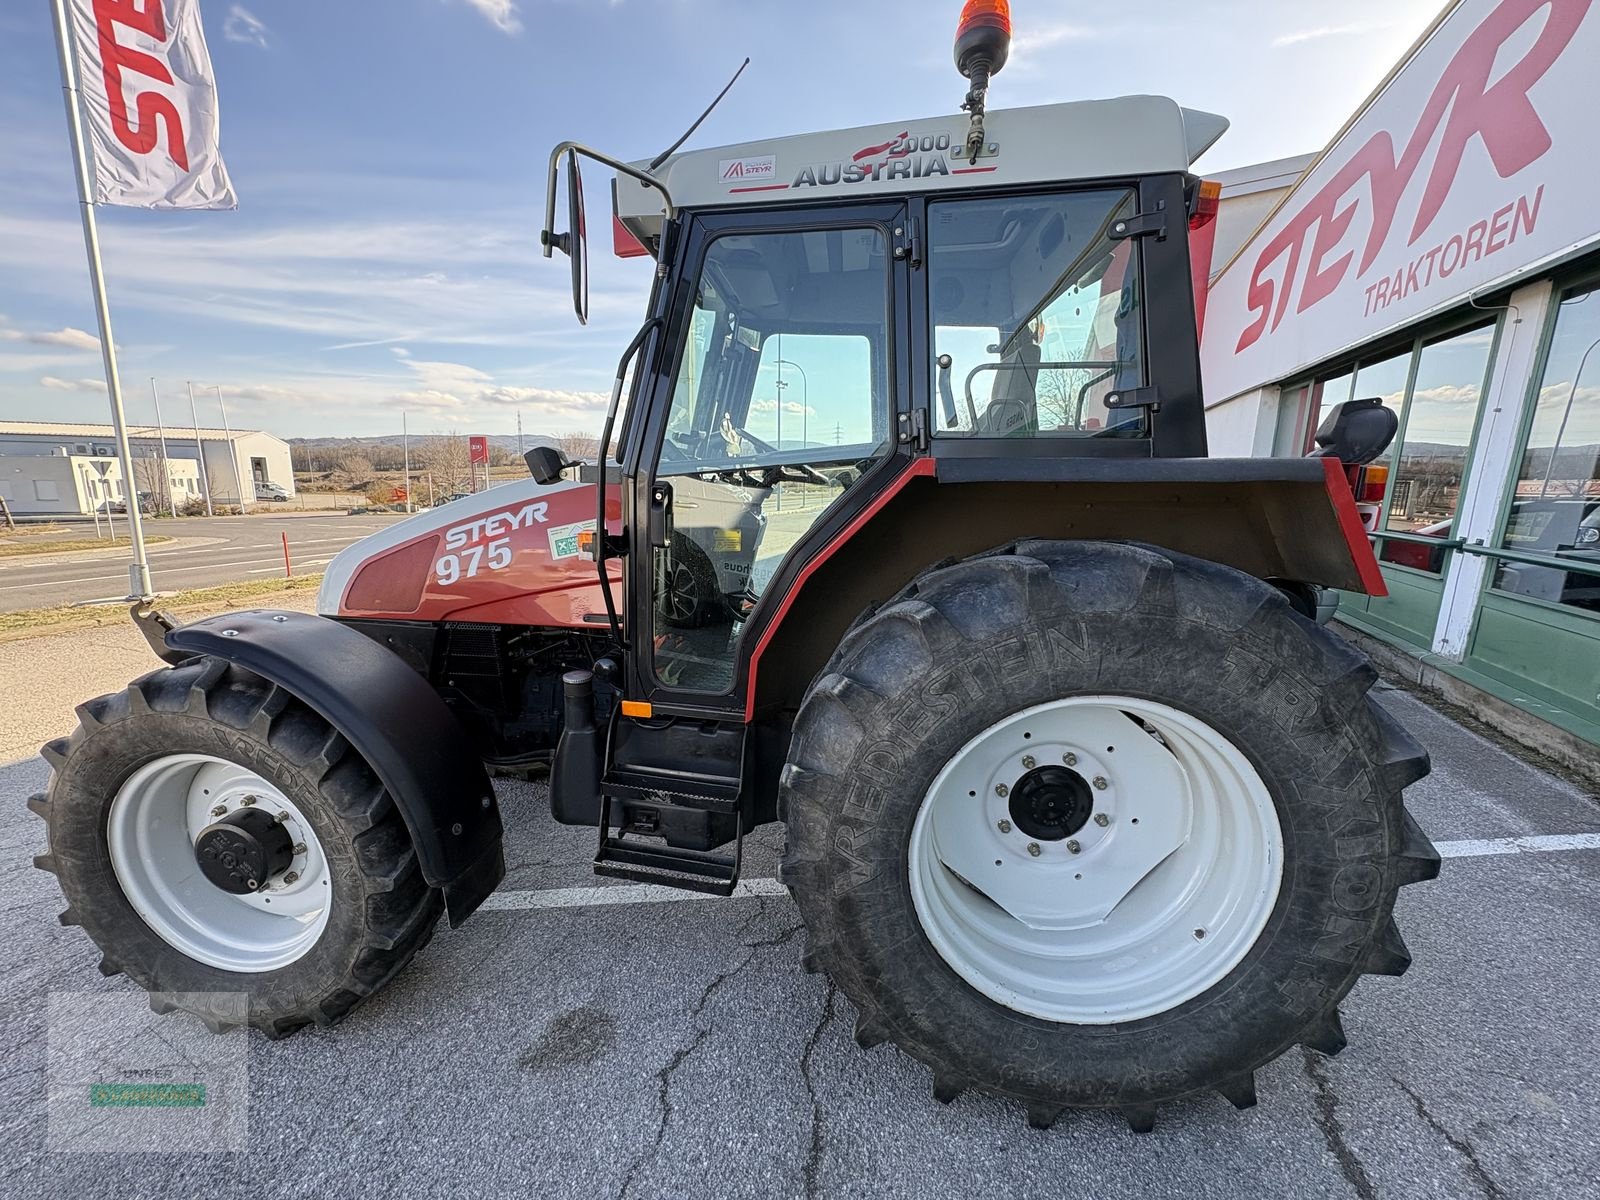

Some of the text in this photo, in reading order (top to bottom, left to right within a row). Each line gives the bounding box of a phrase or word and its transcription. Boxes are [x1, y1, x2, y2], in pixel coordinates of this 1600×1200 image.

[888, 134, 950, 155] 2000
[791, 154, 950, 188] AUSTRIA
[1234, 0, 1593, 356] STEYR
[1363, 183, 1545, 318] TRAKTOREN
[445, 501, 549, 551] STEYR
[435, 536, 513, 586] 975
[832, 621, 1091, 896] VREDESTEIN
